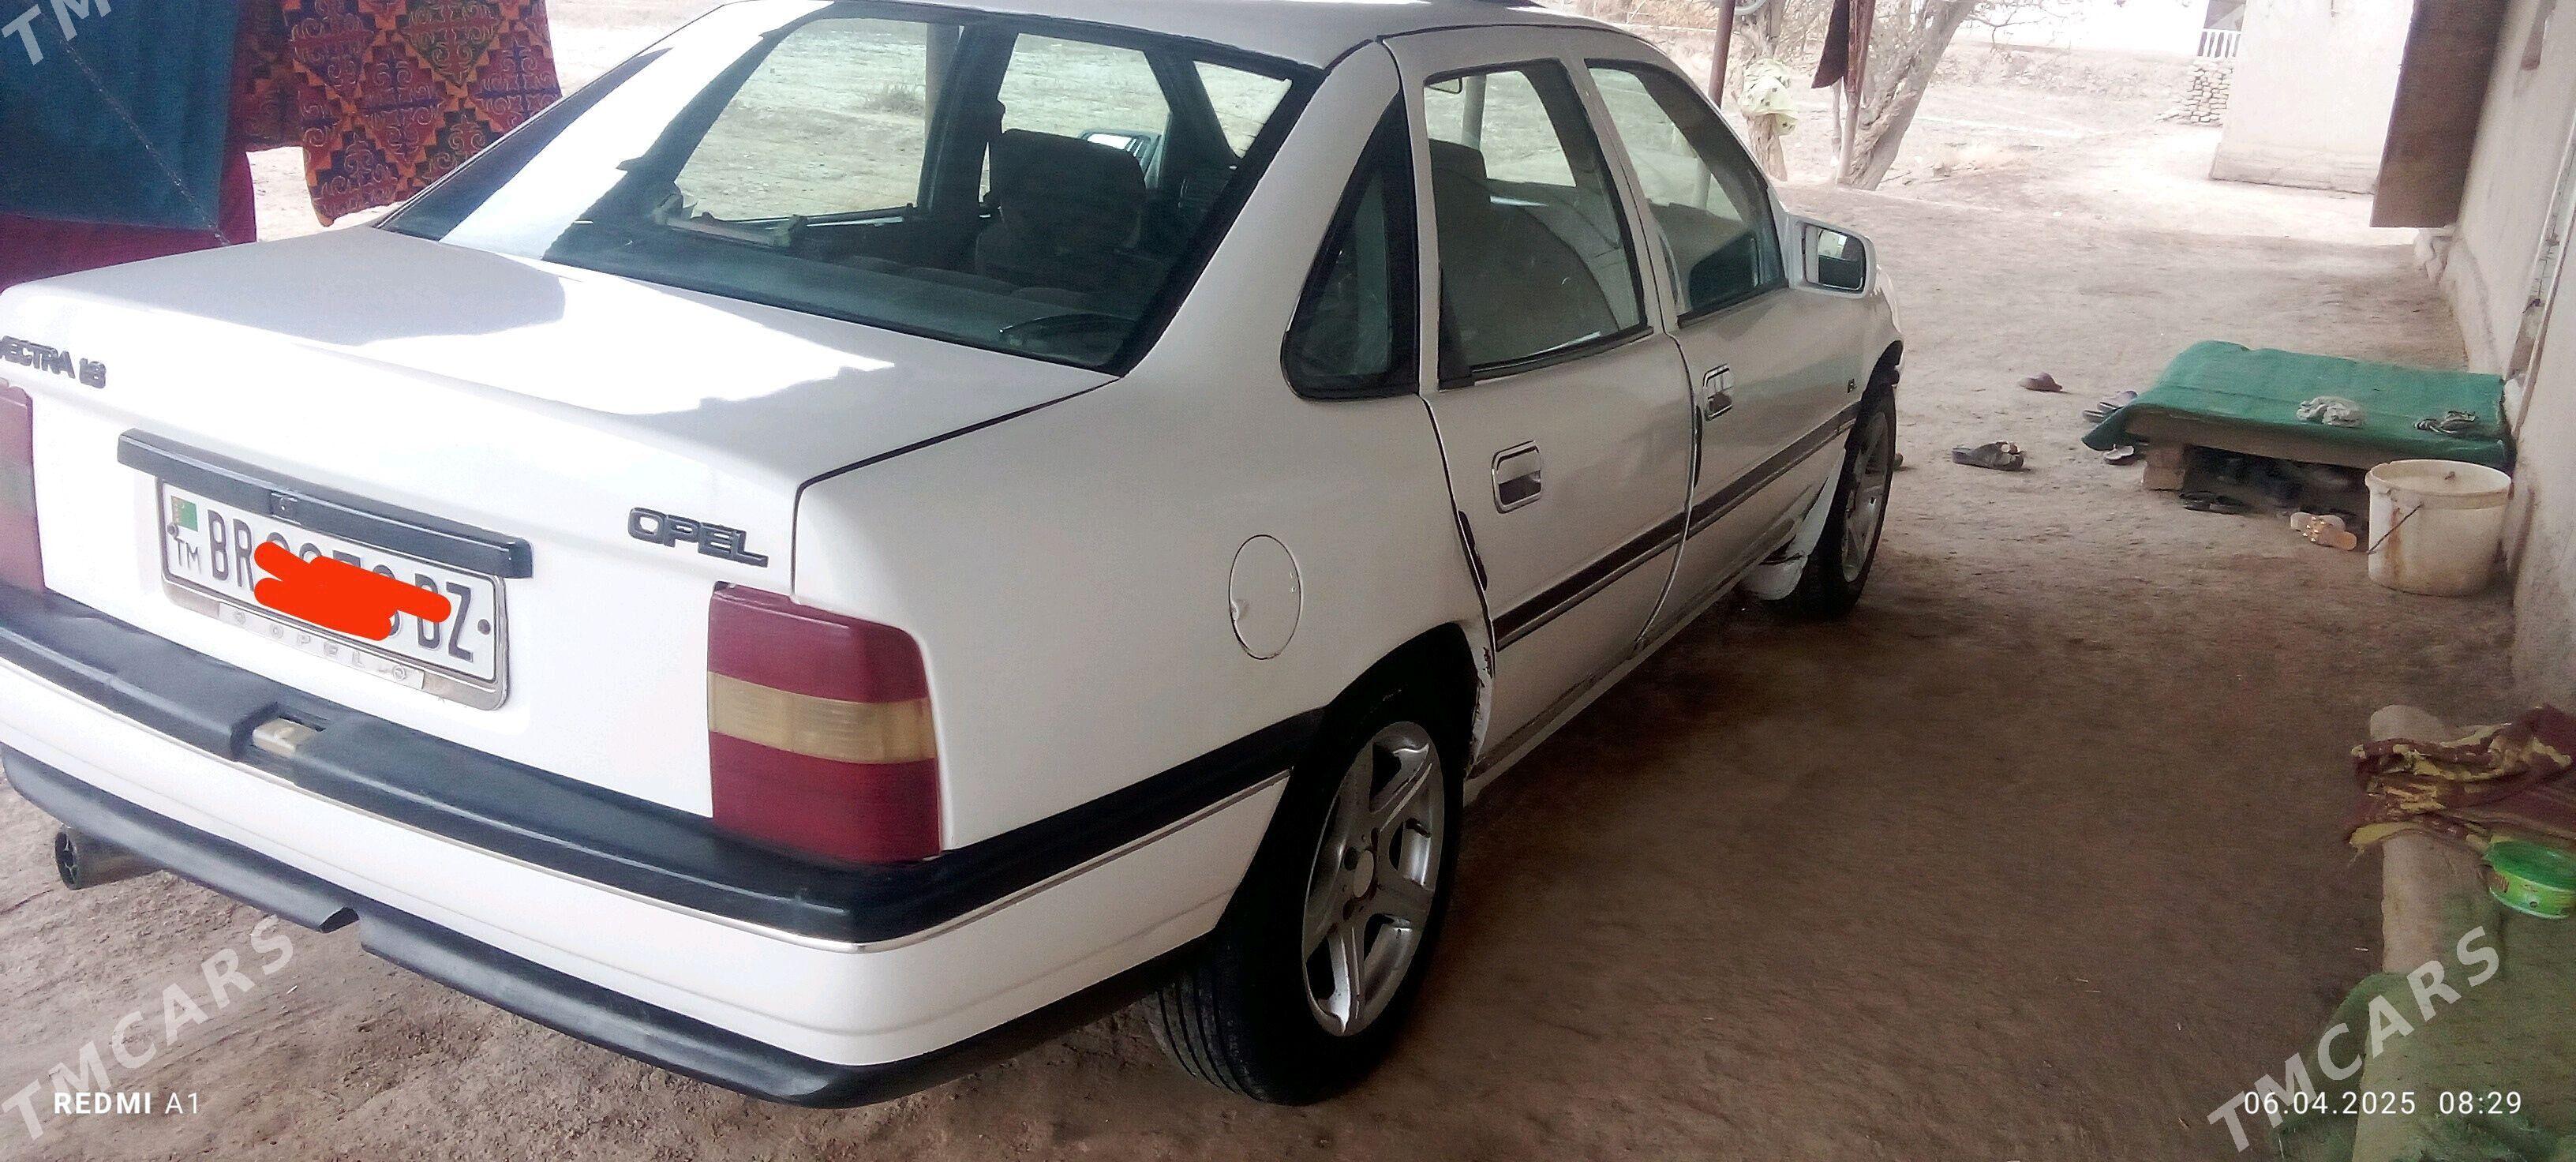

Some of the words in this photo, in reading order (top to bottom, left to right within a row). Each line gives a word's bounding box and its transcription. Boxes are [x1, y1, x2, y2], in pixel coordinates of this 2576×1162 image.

[0, 335, 76, 379] ECTRA
[175, 538, 202, 575] TM
[628, 507, 769, 568] OPEL
[269, 623, 367, 669] OPEL
